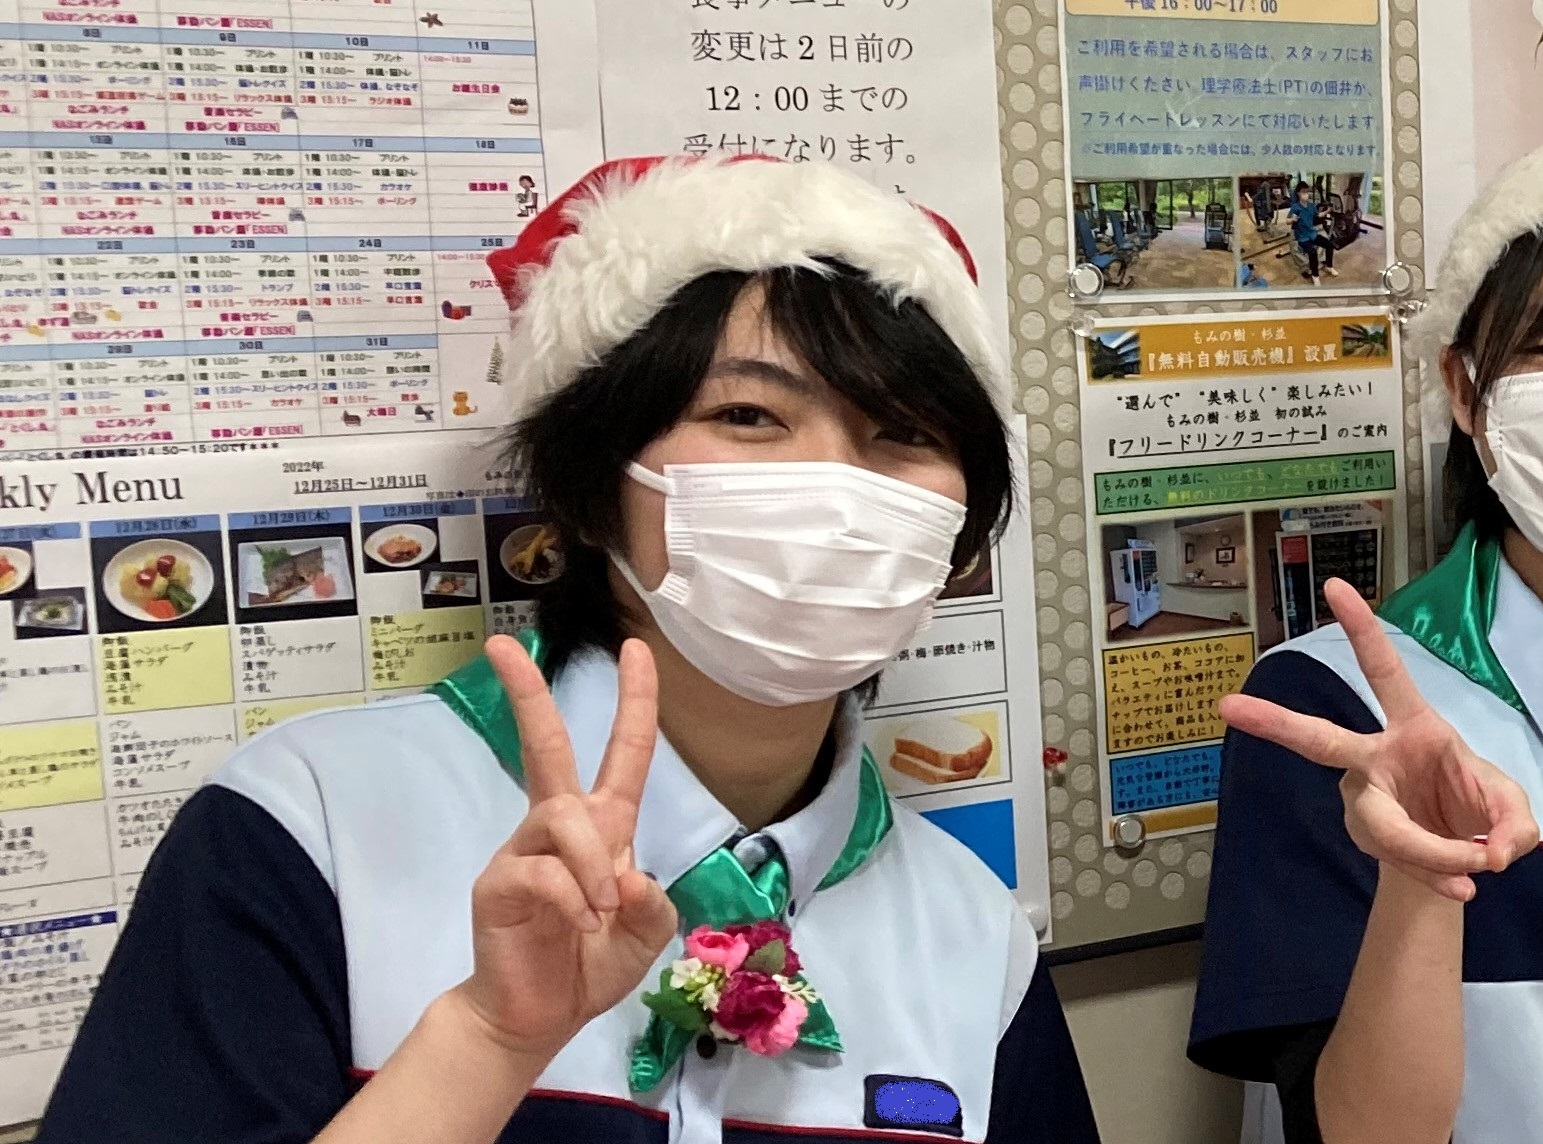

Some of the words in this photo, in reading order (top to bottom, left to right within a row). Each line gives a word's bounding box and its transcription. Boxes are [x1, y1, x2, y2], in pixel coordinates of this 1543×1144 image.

[345, 37, 369, 47] 10日
[468, 41, 490, 51] 11日
[690, 29, 914, 63] 変更は2日前の
[352, 138, 373, 147] 17日
[230, 239, 255, 248] 23日
[359, 239, 382, 248] 24日
[480, 238, 503, 247] 25日
[366, 337, 388, 346] 31日
[1303, 343, 1338, 362] 設置
[1338, 423, 1388, 439] のご案内
[282, 459, 324, 474] 2022年
[72, 470, 184, 505] Menu
